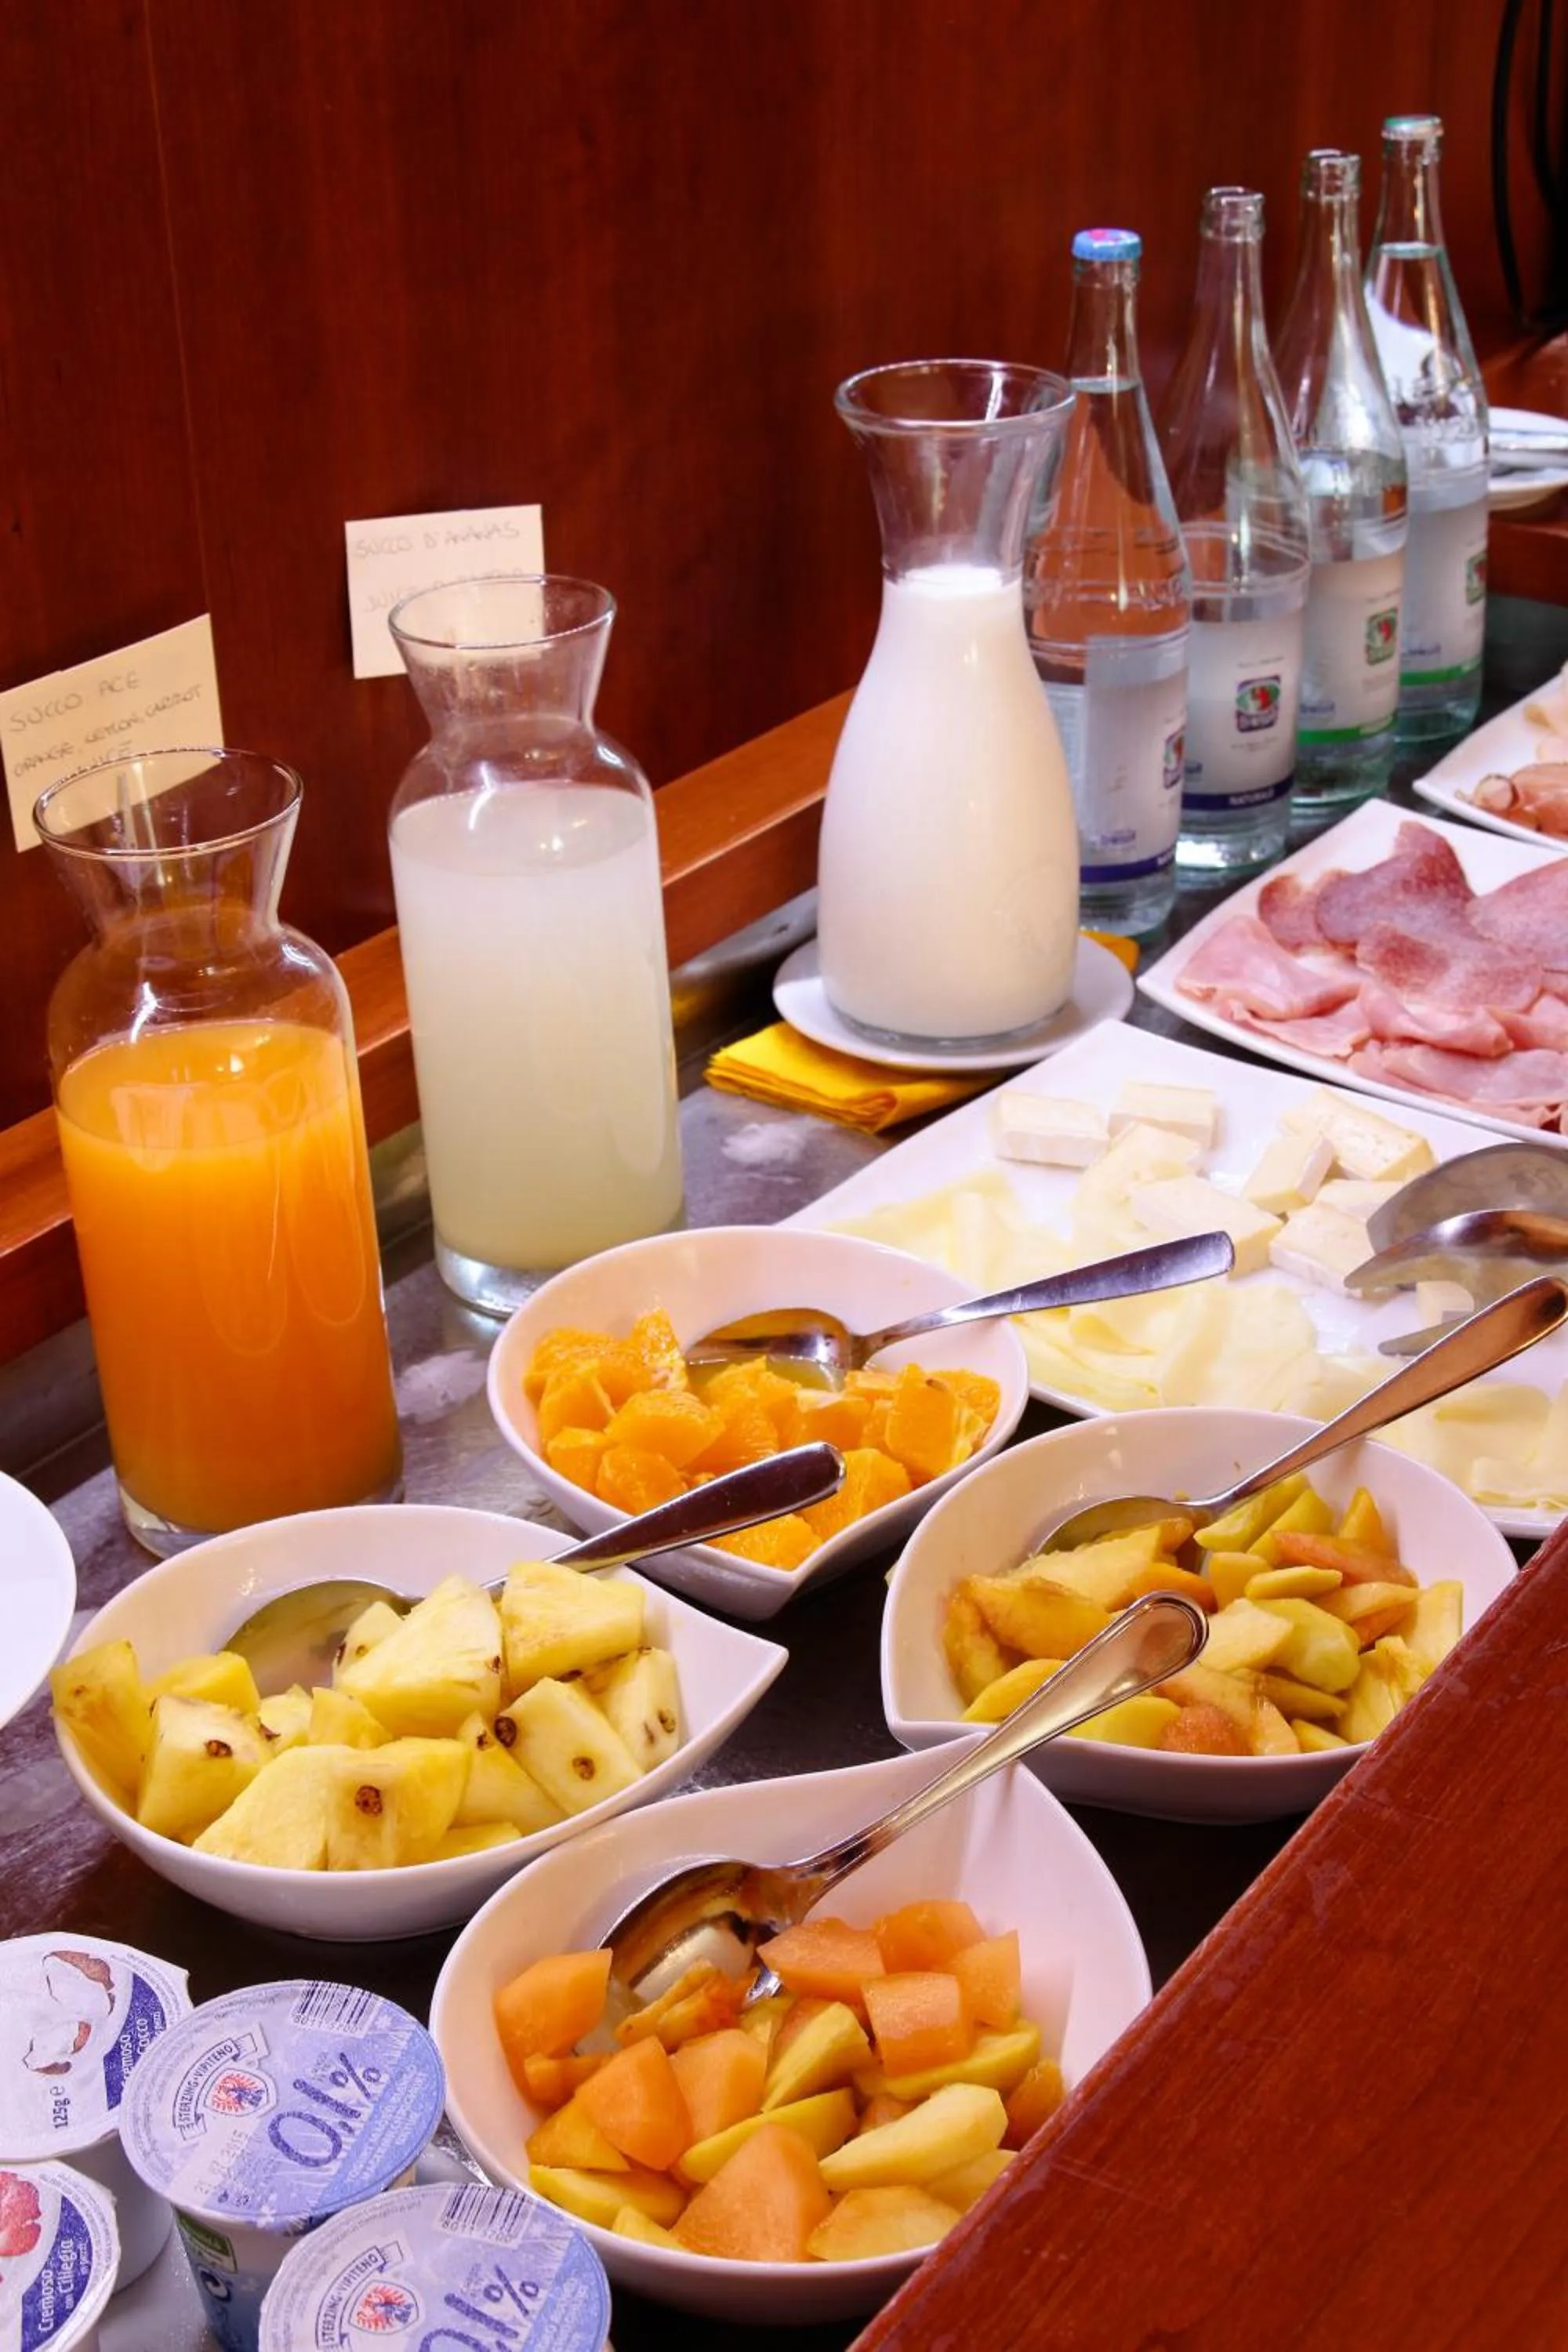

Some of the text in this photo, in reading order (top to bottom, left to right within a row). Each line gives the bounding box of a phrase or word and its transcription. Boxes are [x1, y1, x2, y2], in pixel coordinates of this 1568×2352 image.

[9, 671, 140, 732] SUCCO ACE
[38, 2270, 54, 2332] Cremoso
